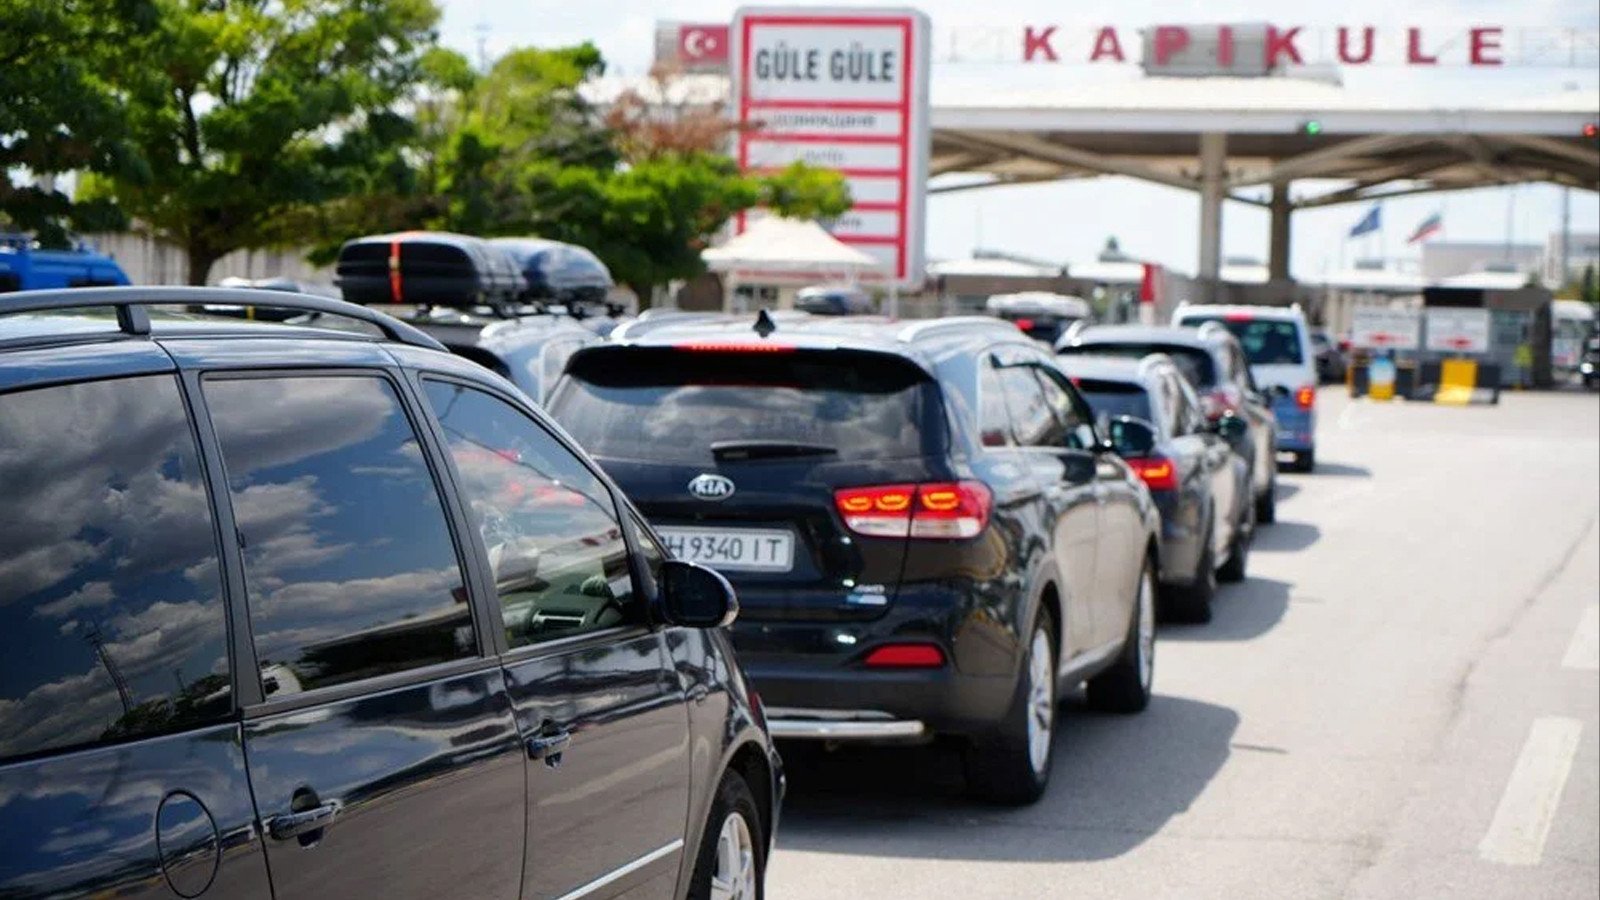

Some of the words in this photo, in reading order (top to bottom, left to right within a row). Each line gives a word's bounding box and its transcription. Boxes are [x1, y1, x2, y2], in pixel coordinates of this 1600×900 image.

[756, 41, 819, 81] GÜLE
[830, 42, 894, 82] GÜLE
[695, 477, 727, 494] KIA
[690, 537, 743, 560] 9340
